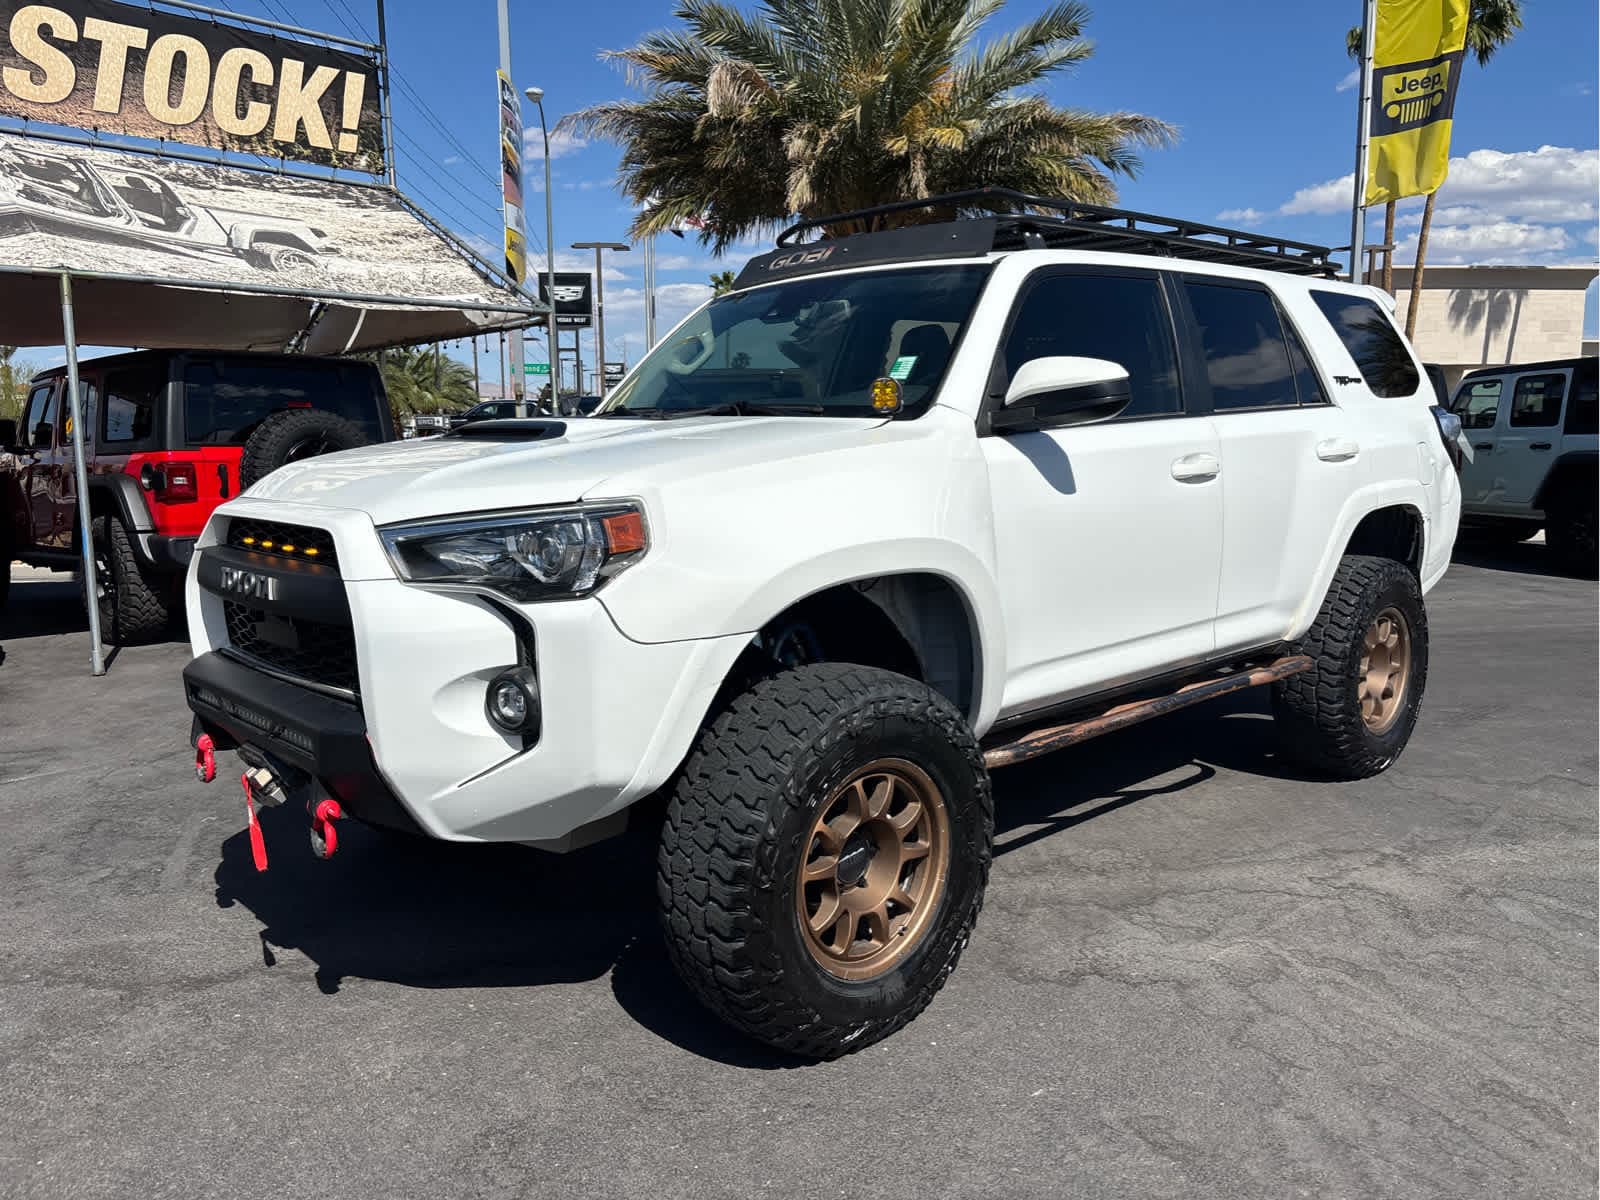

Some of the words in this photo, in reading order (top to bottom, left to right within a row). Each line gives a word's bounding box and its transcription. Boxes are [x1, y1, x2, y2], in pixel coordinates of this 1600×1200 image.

[2, 5, 366, 152] STOCK!
[1395, 73, 1440, 94] Jeep
[768, 247, 835, 271] GOBI
